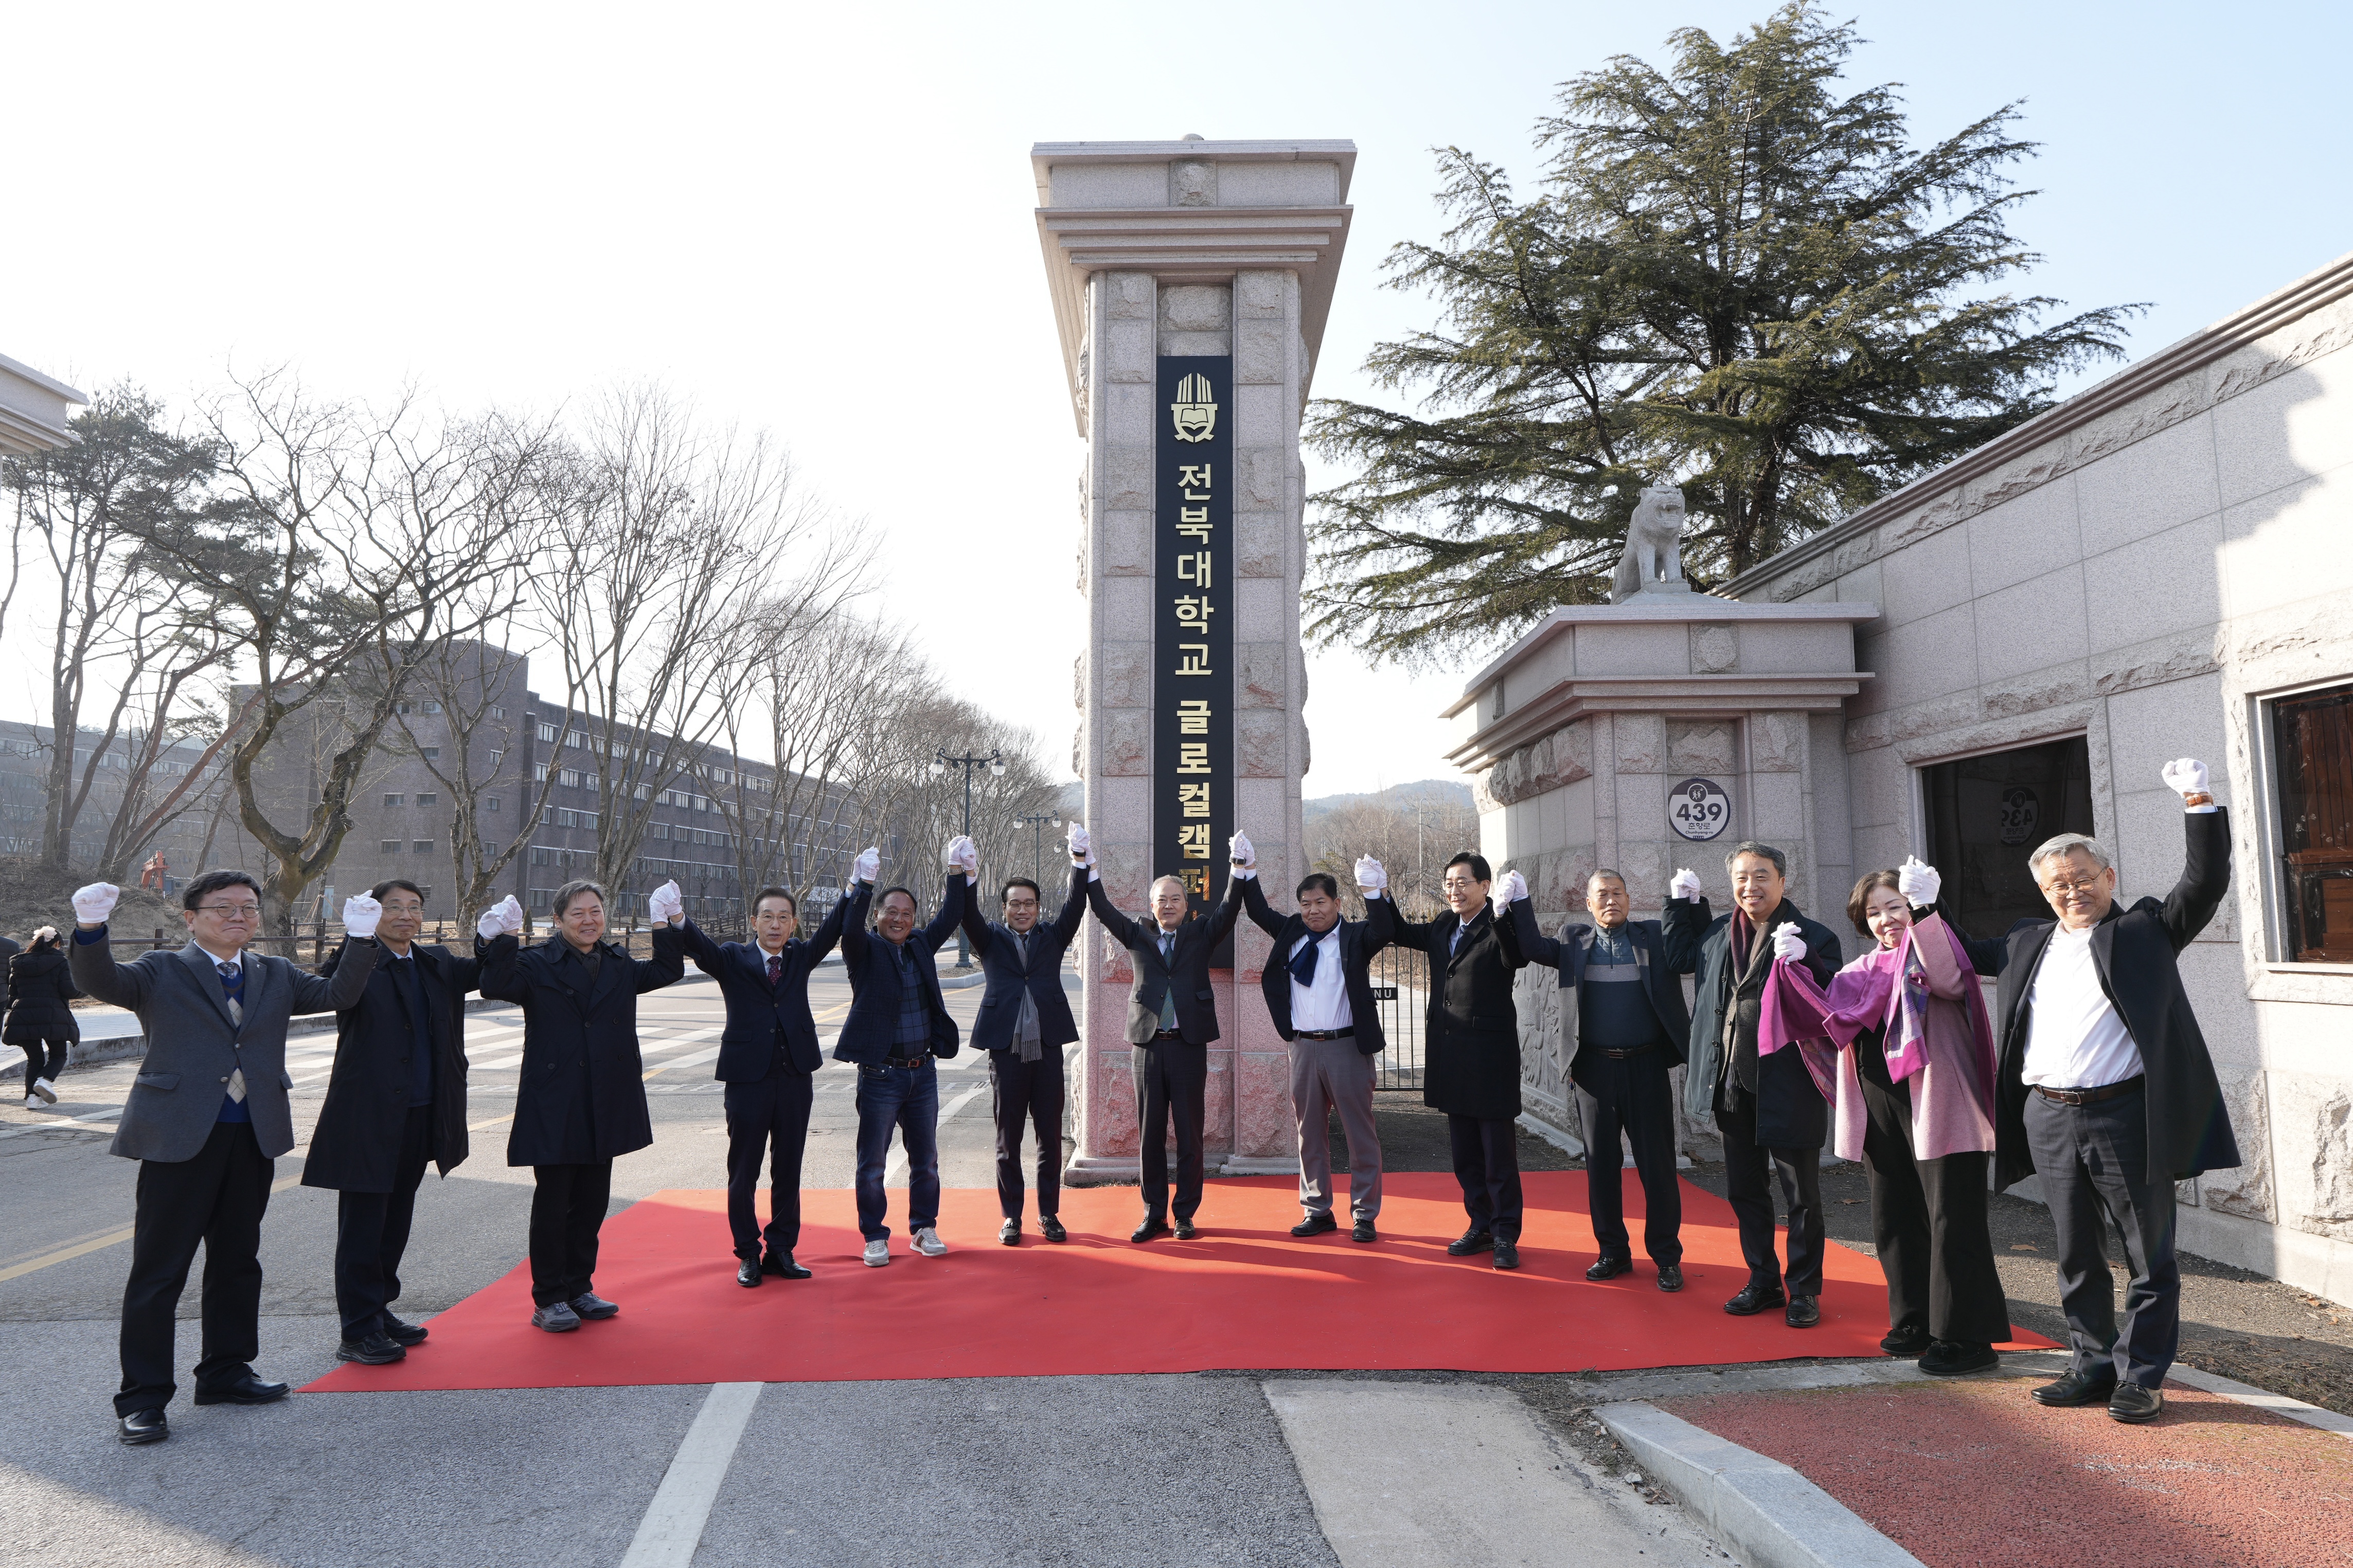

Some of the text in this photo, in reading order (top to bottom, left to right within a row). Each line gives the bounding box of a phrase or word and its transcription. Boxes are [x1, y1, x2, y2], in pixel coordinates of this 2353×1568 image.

[1174, 464, 1215, 924] 전북대학교 글로컬캠퍼
[1676, 803, 1722, 822] 439
[1374, 989, 1392, 999] NU
